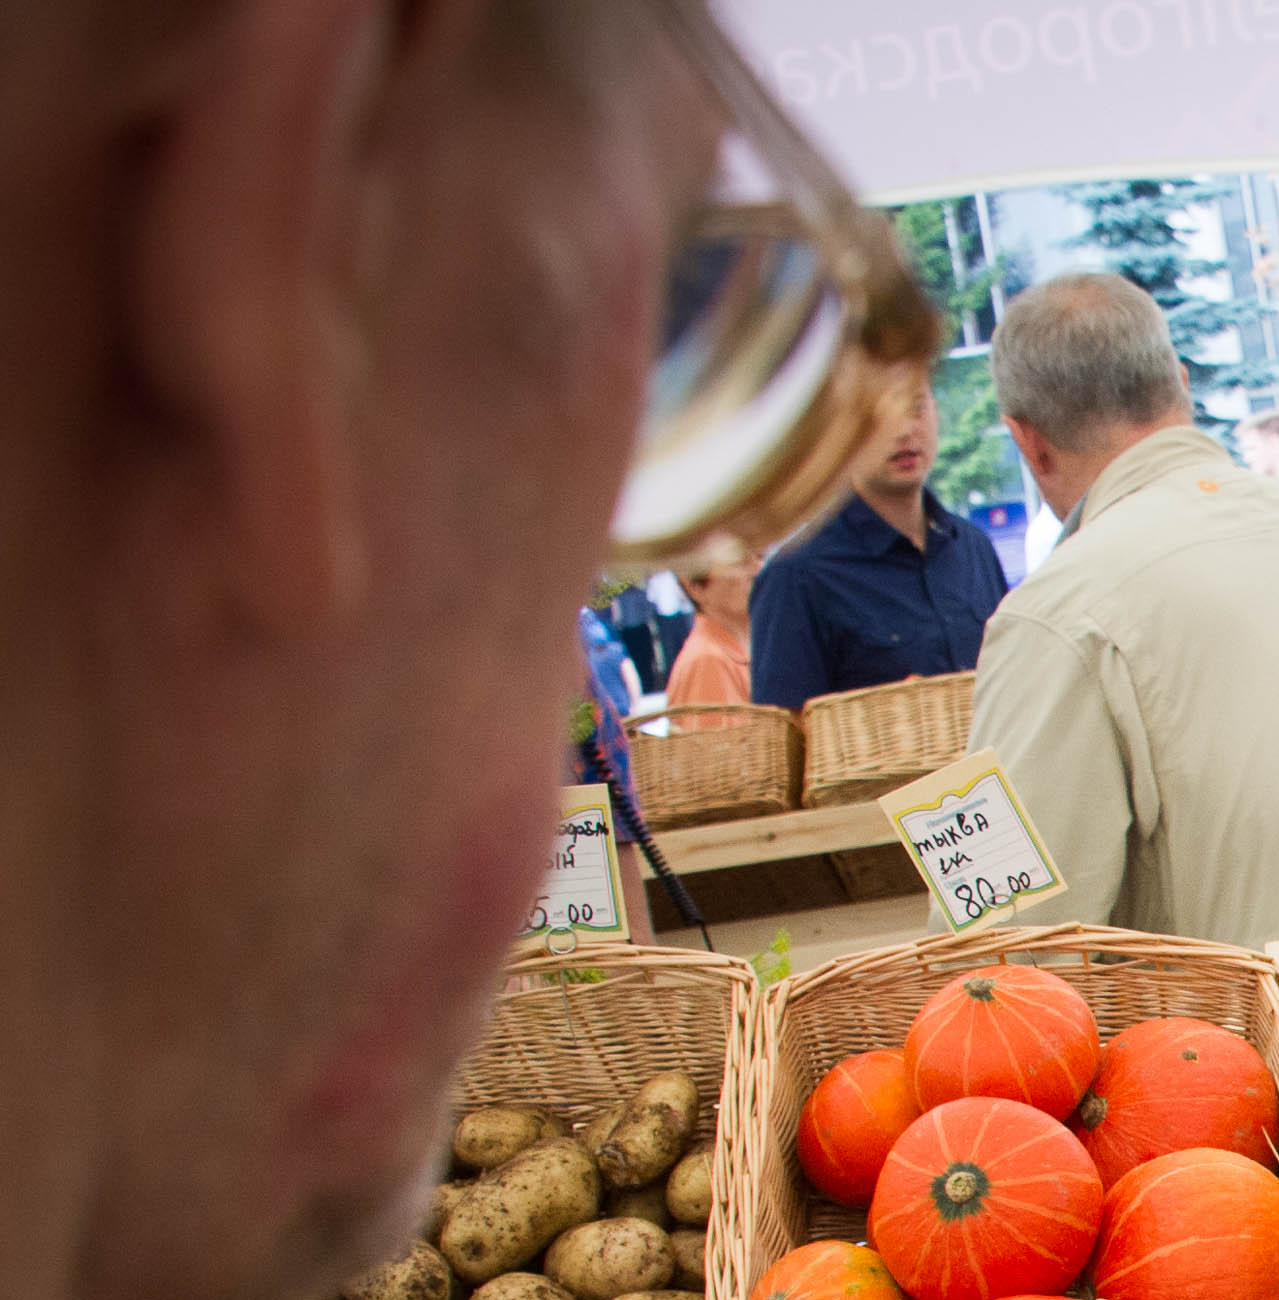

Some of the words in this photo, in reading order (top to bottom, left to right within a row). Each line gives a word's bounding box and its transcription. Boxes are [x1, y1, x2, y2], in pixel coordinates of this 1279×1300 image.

[528, 896, 549, 930] 5
[568, 904, 593, 924] 00
[955, 877, 996, 919] 80
[1007, 872, 1030, 894] 00
